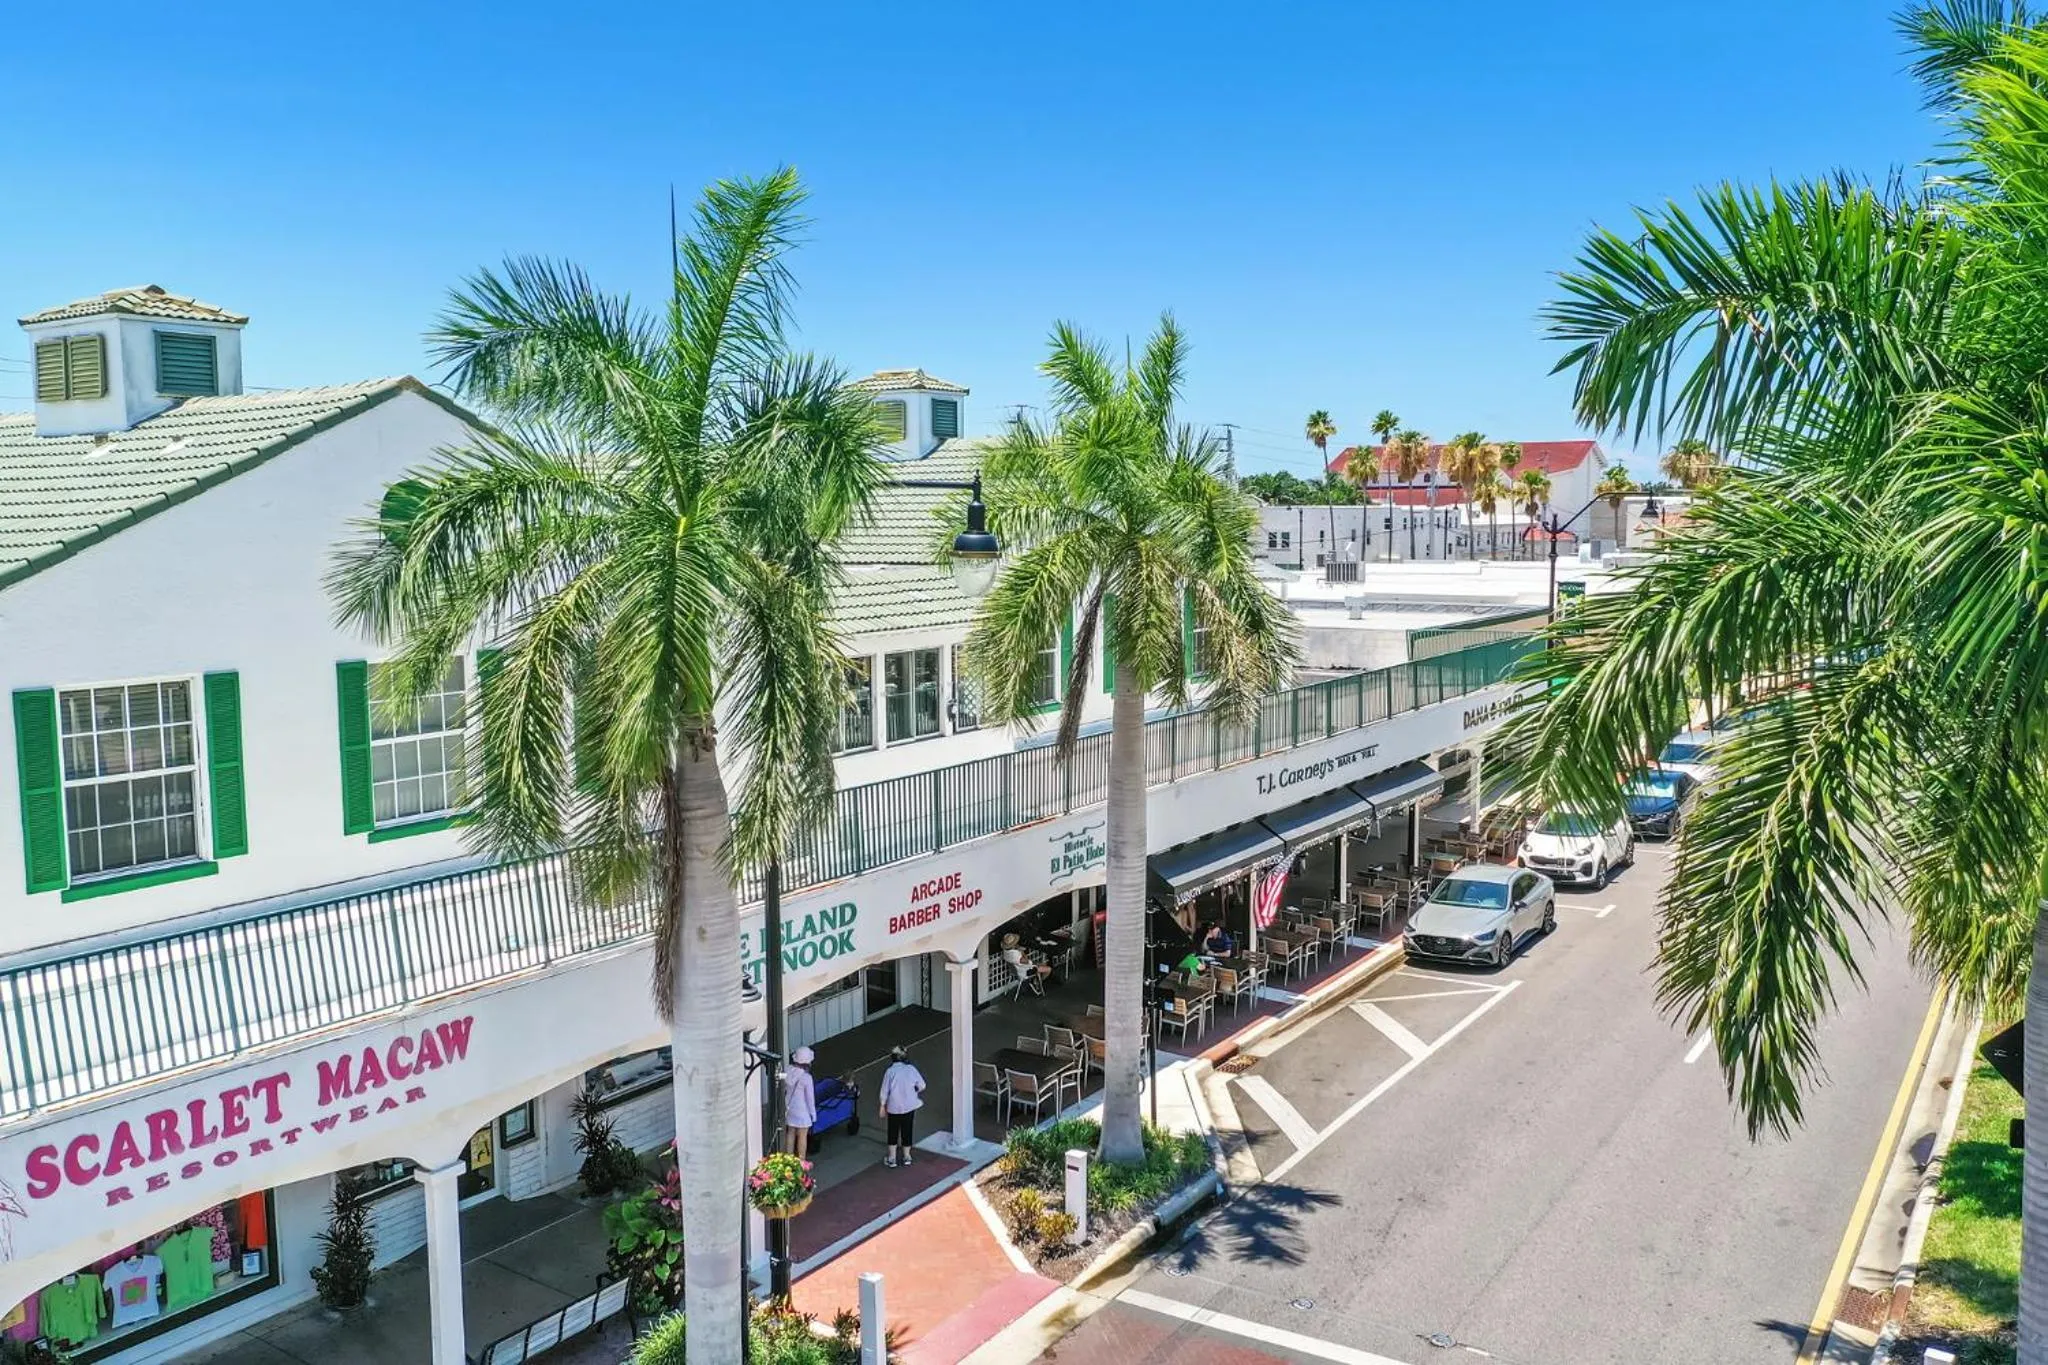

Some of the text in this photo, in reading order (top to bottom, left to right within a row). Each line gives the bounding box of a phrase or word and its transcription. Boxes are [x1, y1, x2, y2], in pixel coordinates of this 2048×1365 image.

[1256, 773, 1276, 795] T.J.
[1050, 842, 1106, 874] El Patio Hotel
[911, 872, 962, 904] ARCADE
[889, 889, 983, 934] BARBER SHOP
[780, 929, 857, 975] NOOK
[25, 1015, 475, 1200] SCARLET MACAW
[105, 1086, 427, 1207] RESORTWEAR
